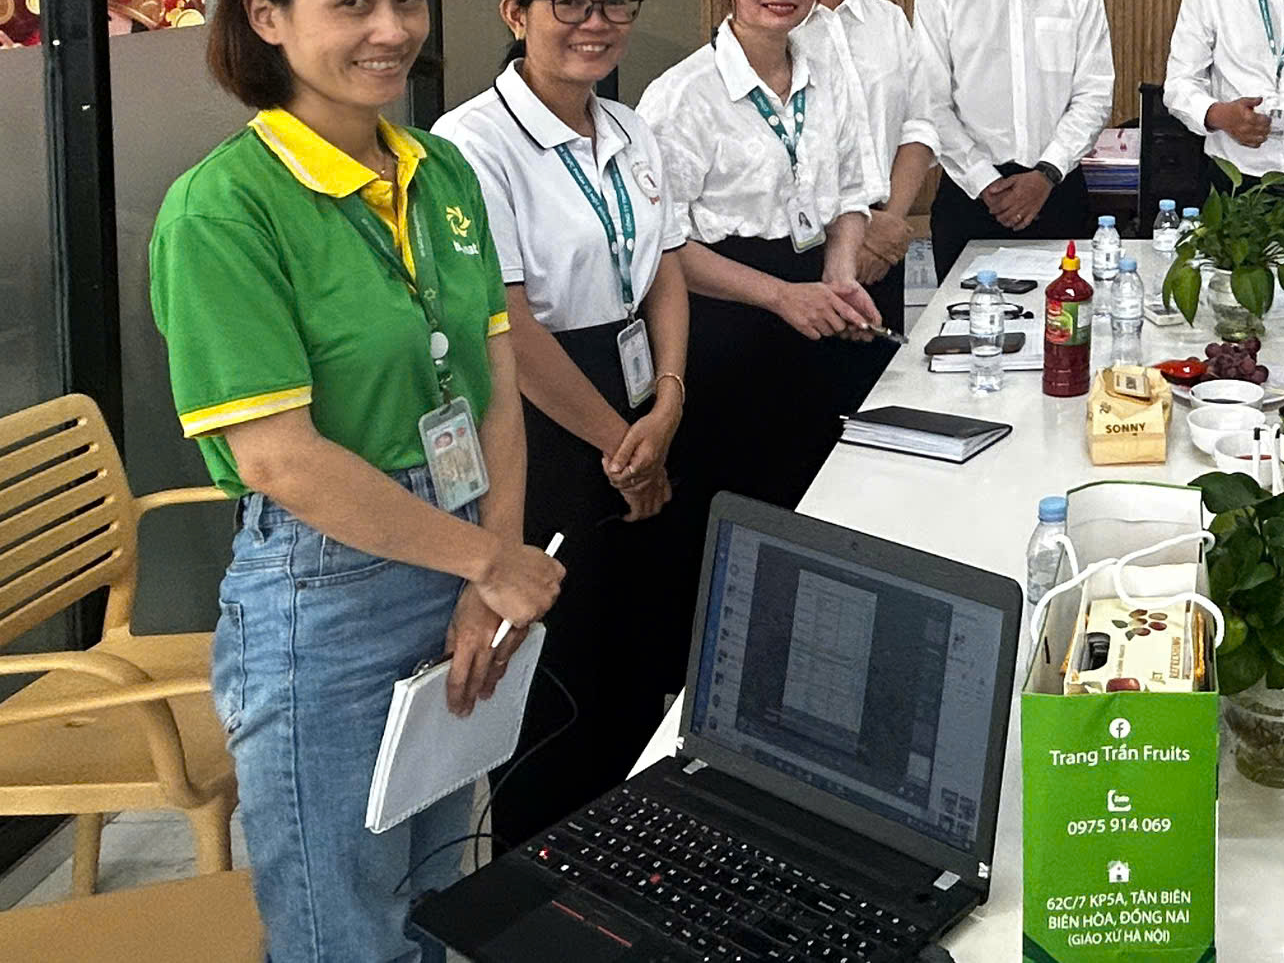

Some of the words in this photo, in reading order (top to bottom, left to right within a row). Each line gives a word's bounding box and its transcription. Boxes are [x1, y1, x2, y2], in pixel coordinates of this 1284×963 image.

[1105, 422, 1146, 434] SONNY
[1049, 749, 1099, 767] Trang
[1143, 745, 1191, 762] Fruits
[1067, 819, 1106, 836] 0975
[1109, 817, 1139, 832] 914
[1141, 817, 1172, 833] 069
[1046, 894, 1087, 911] 62C/7
[1089, 891, 1128, 908] KP5A,
[1130, 889, 1158, 905] TÂN
[1160, 888, 1192, 905] BIÊN
[1048, 913, 1080, 930] BIÊN
[1082, 911, 1117, 927] HÒA,
[1119, 908, 1163, 925] ĐỒNG
[1165, 909, 1190, 924] NAI
[1067, 931, 1102, 947] (GIÁO
[1123, 928, 1142, 943] HÀ
[1143, 928, 1171, 945] NỘI)
